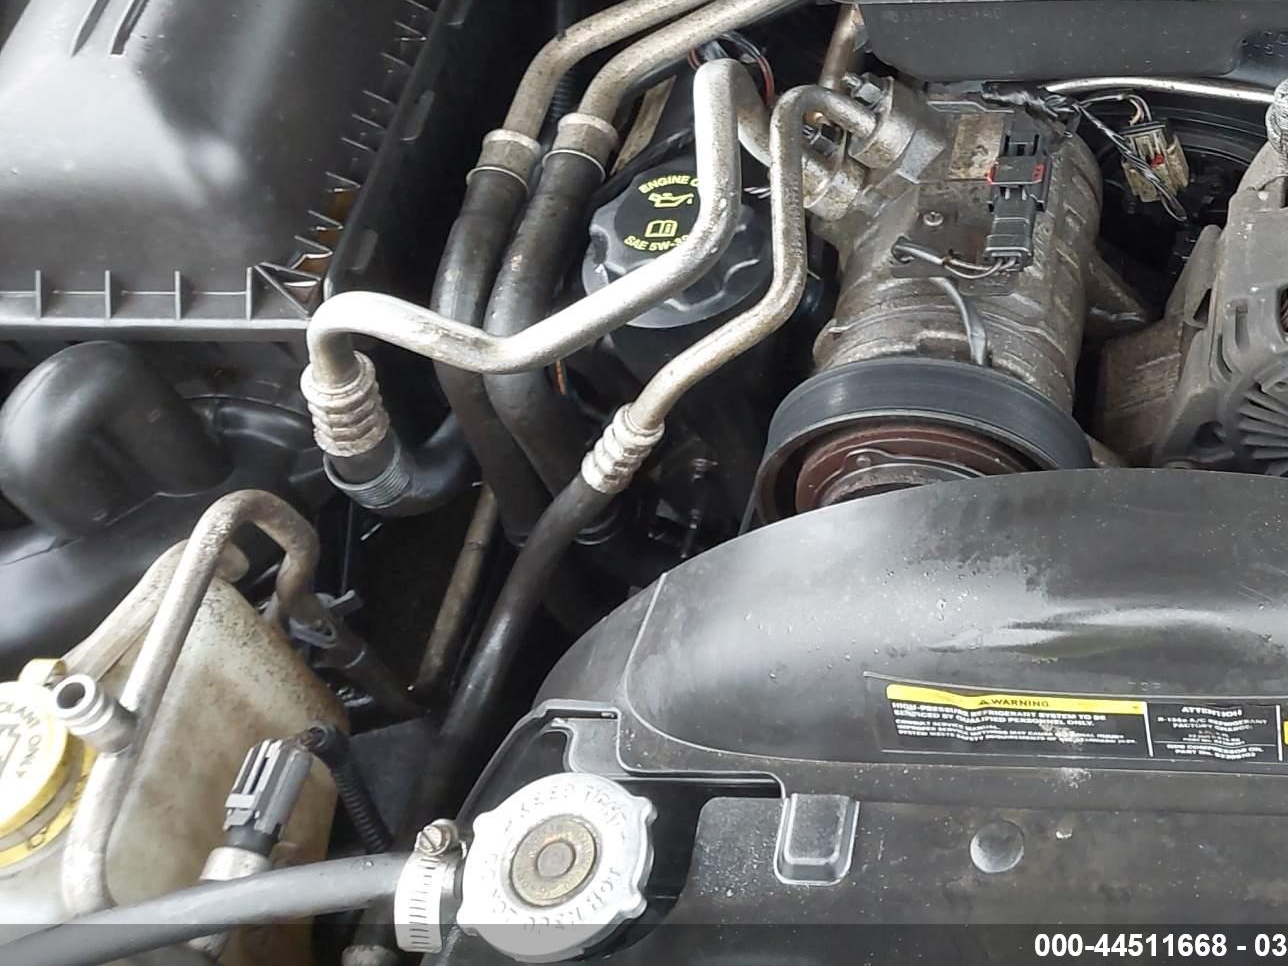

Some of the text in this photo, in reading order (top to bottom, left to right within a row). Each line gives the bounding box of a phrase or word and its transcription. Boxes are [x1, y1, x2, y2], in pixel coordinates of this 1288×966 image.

[638, 175, 690, 193] ENGINE
[623, 235, 648, 251] SAE
[990, 698, 1050, 708] WARNING
[955, 715, 1007, 724] QUALIFIED
[1007, 716, 1066, 725] PERSONNEL
[970, 709, 1037, 718] REFRIGERANT
[1038, 712, 1077, 720] SYSTEM
